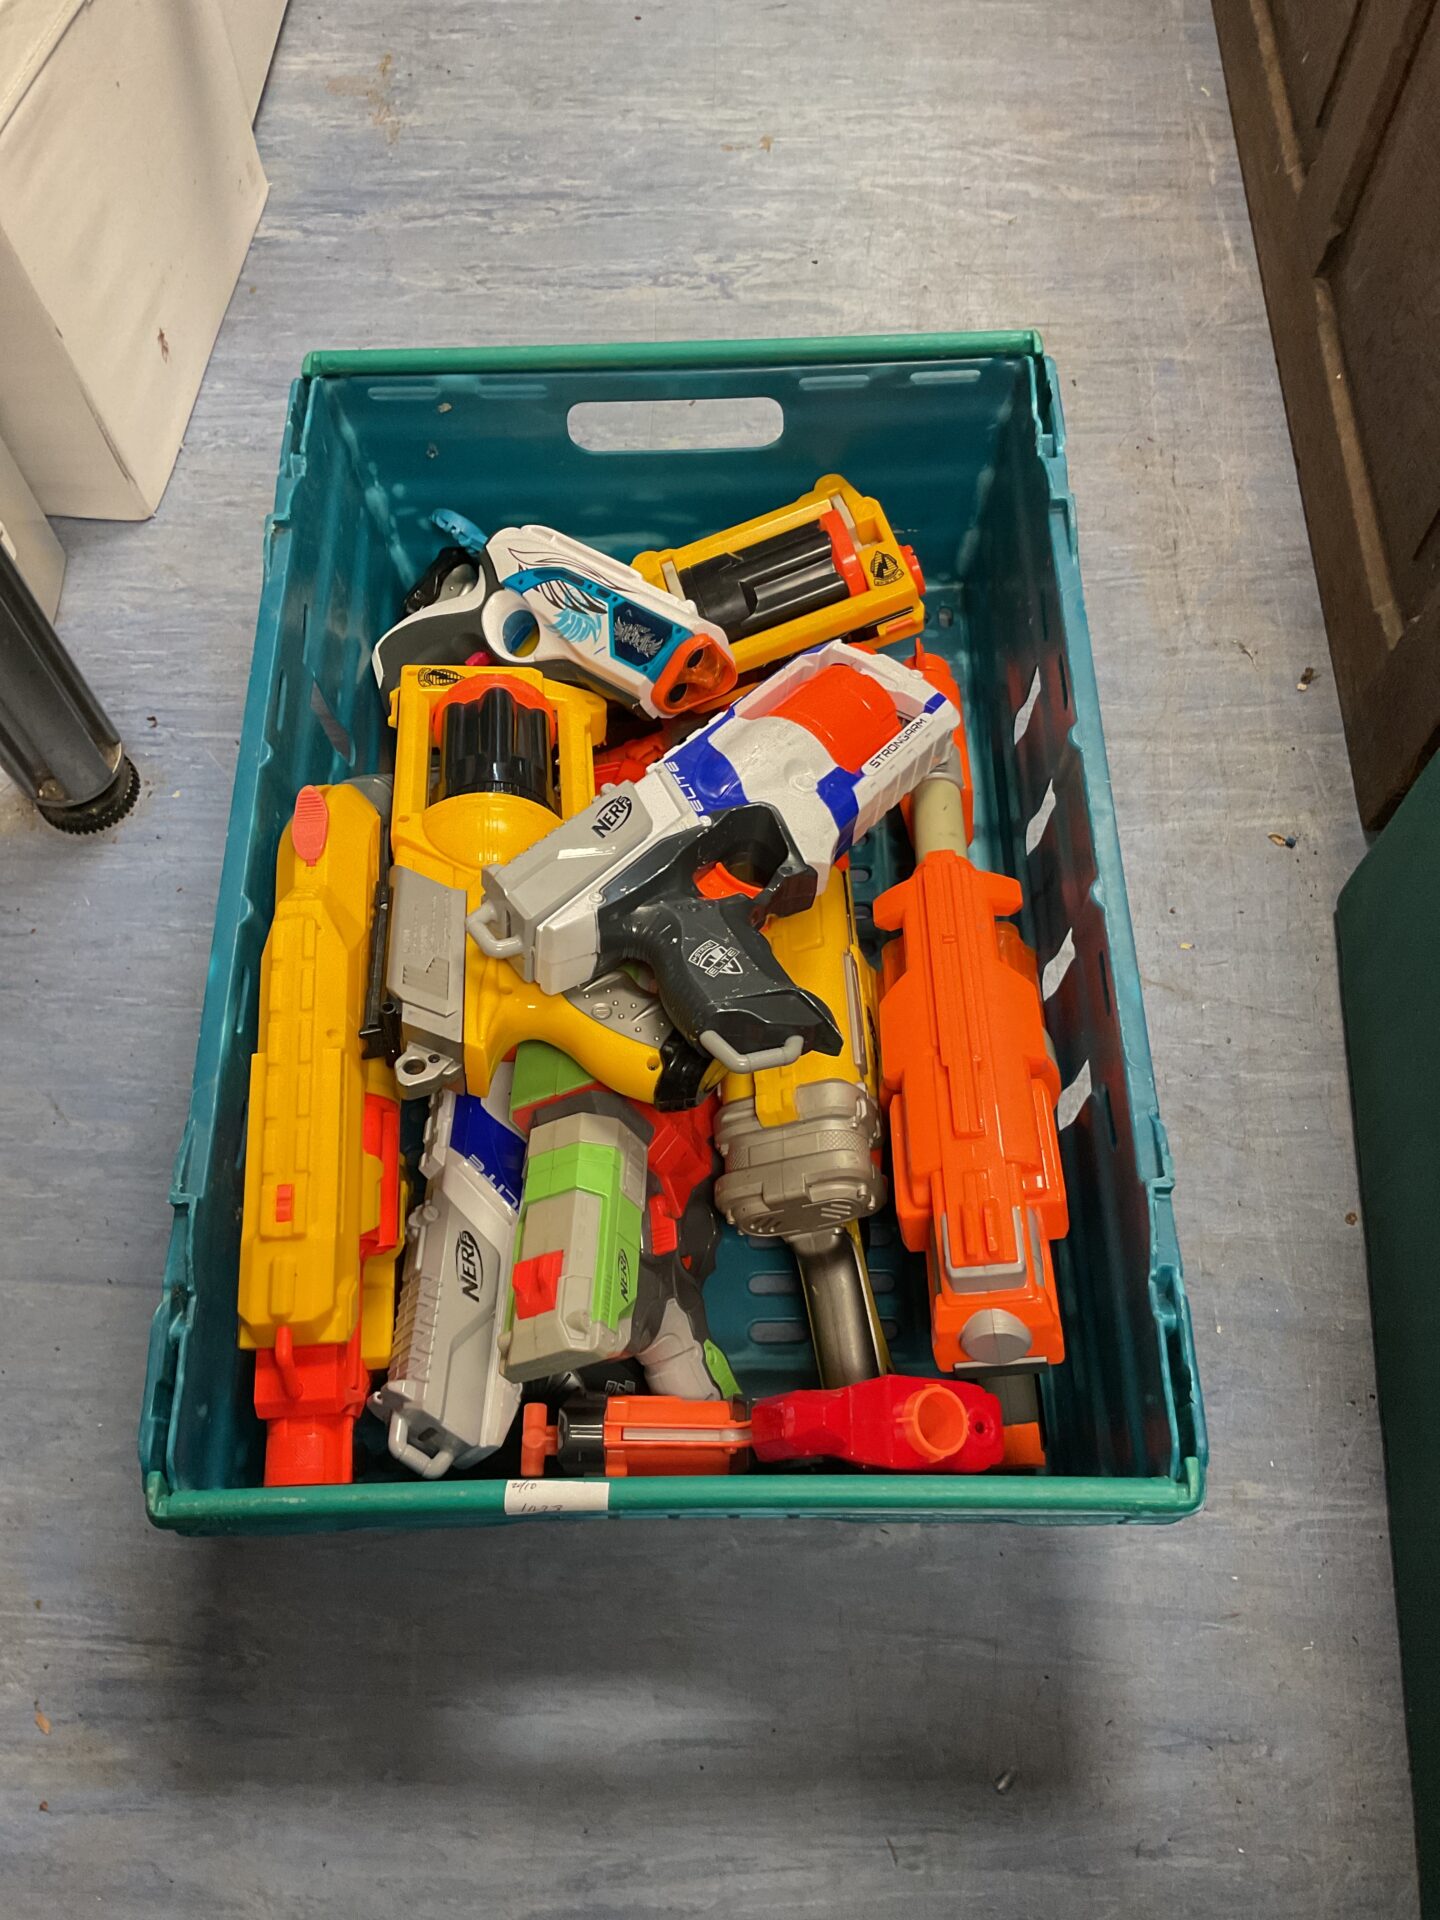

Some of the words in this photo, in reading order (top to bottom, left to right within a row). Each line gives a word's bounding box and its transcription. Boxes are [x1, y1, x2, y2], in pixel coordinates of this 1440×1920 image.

[869, 718, 927, 768] STRONGARM
[665, 761, 704, 812] ELITE
[592, 796, 632, 839] NERF
[708, 949, 737, 975] ELITE
[467, 1153, 519, 1211] LITE
[459, 1231, 480, 1303] NERF
